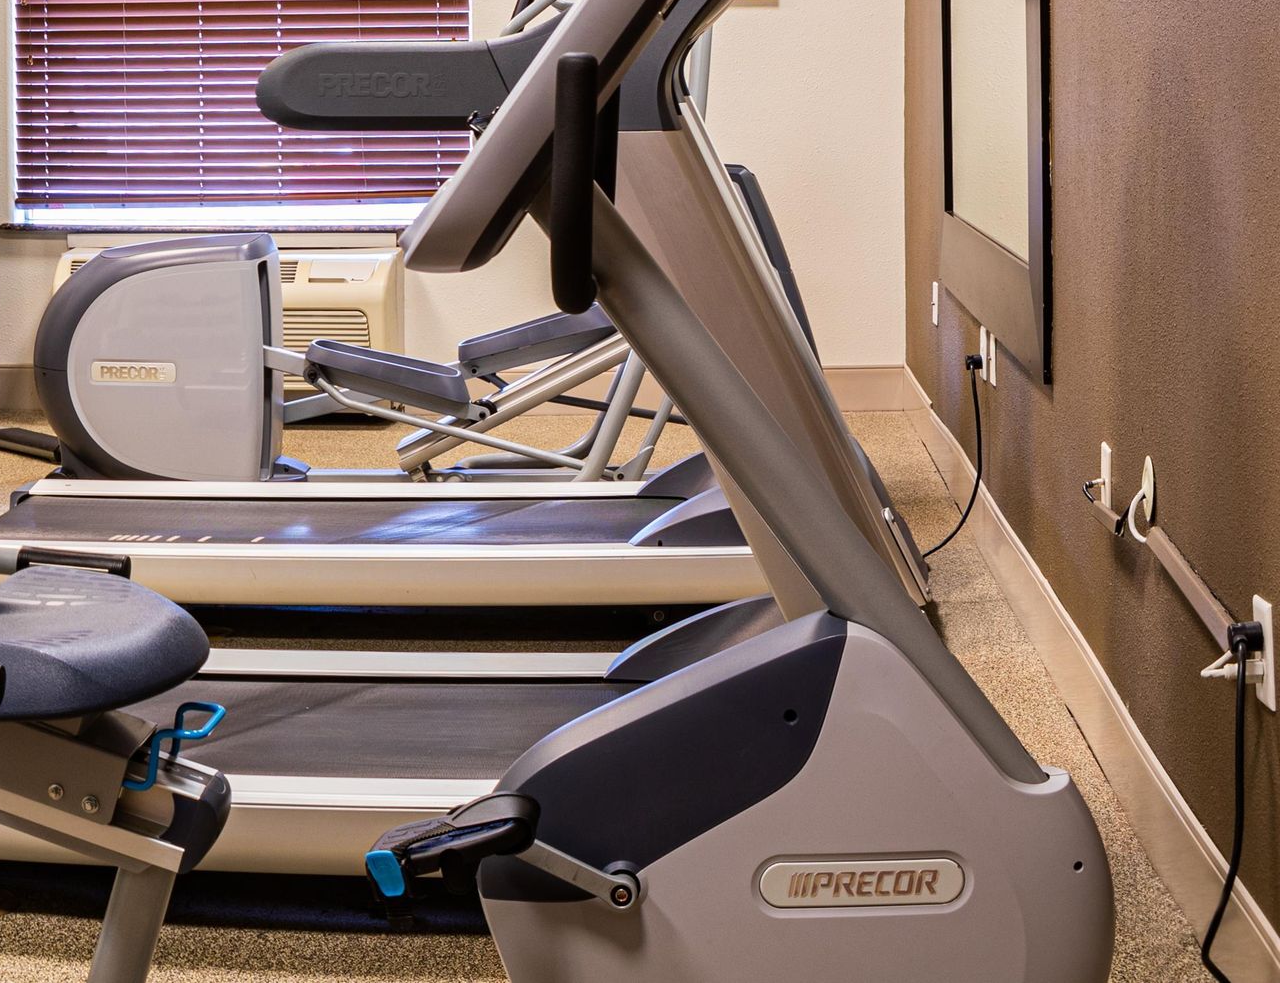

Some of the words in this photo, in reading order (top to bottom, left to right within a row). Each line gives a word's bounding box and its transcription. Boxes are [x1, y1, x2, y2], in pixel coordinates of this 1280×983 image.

[318, 71, 432, 98] PRECOR
[100, 365, 159, 380] PRECOR
[809, 869, 940, 898] PRECOR
